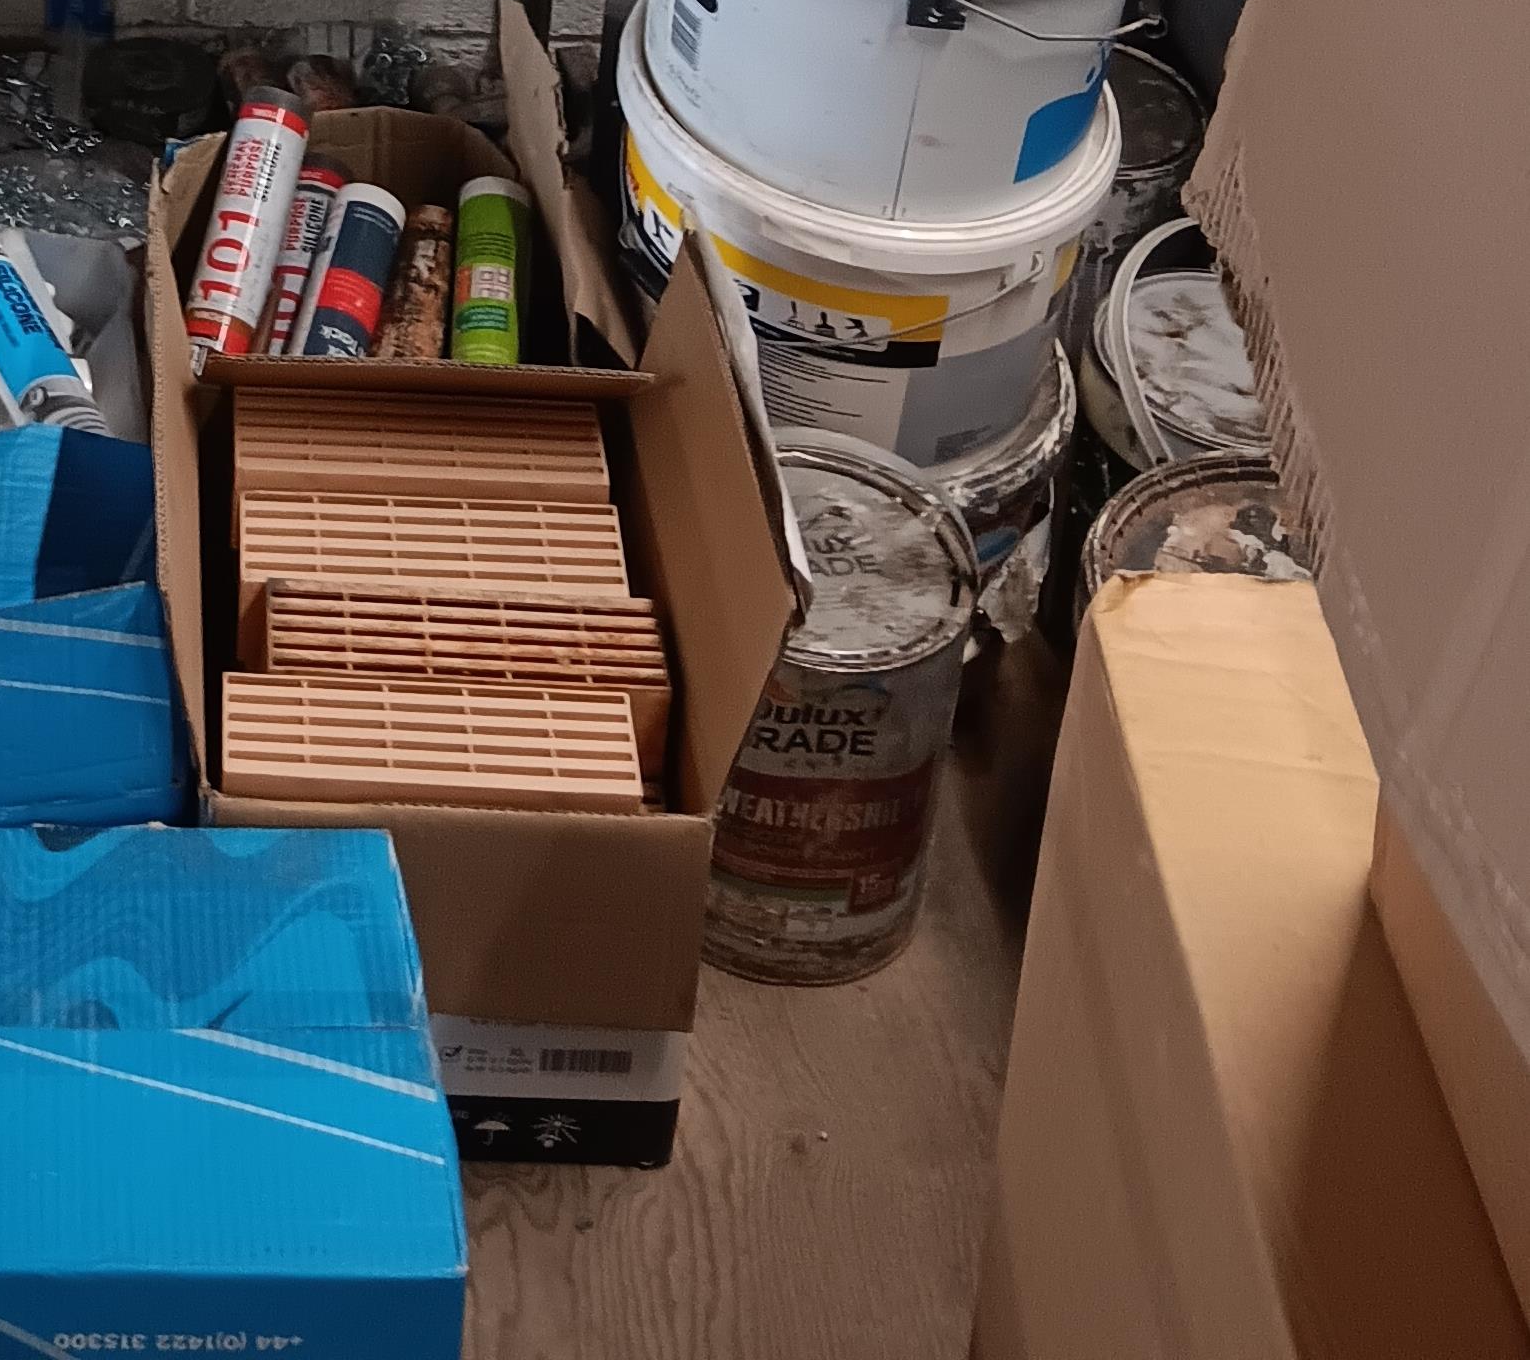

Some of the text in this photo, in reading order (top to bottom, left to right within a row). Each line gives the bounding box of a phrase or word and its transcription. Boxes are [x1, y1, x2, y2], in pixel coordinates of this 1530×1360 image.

[301, 198, 325, 255] SILICONE
[198, 209, 261, 302] 101
[54, 1331, 303, 1352] +44 (0)1422 315300
